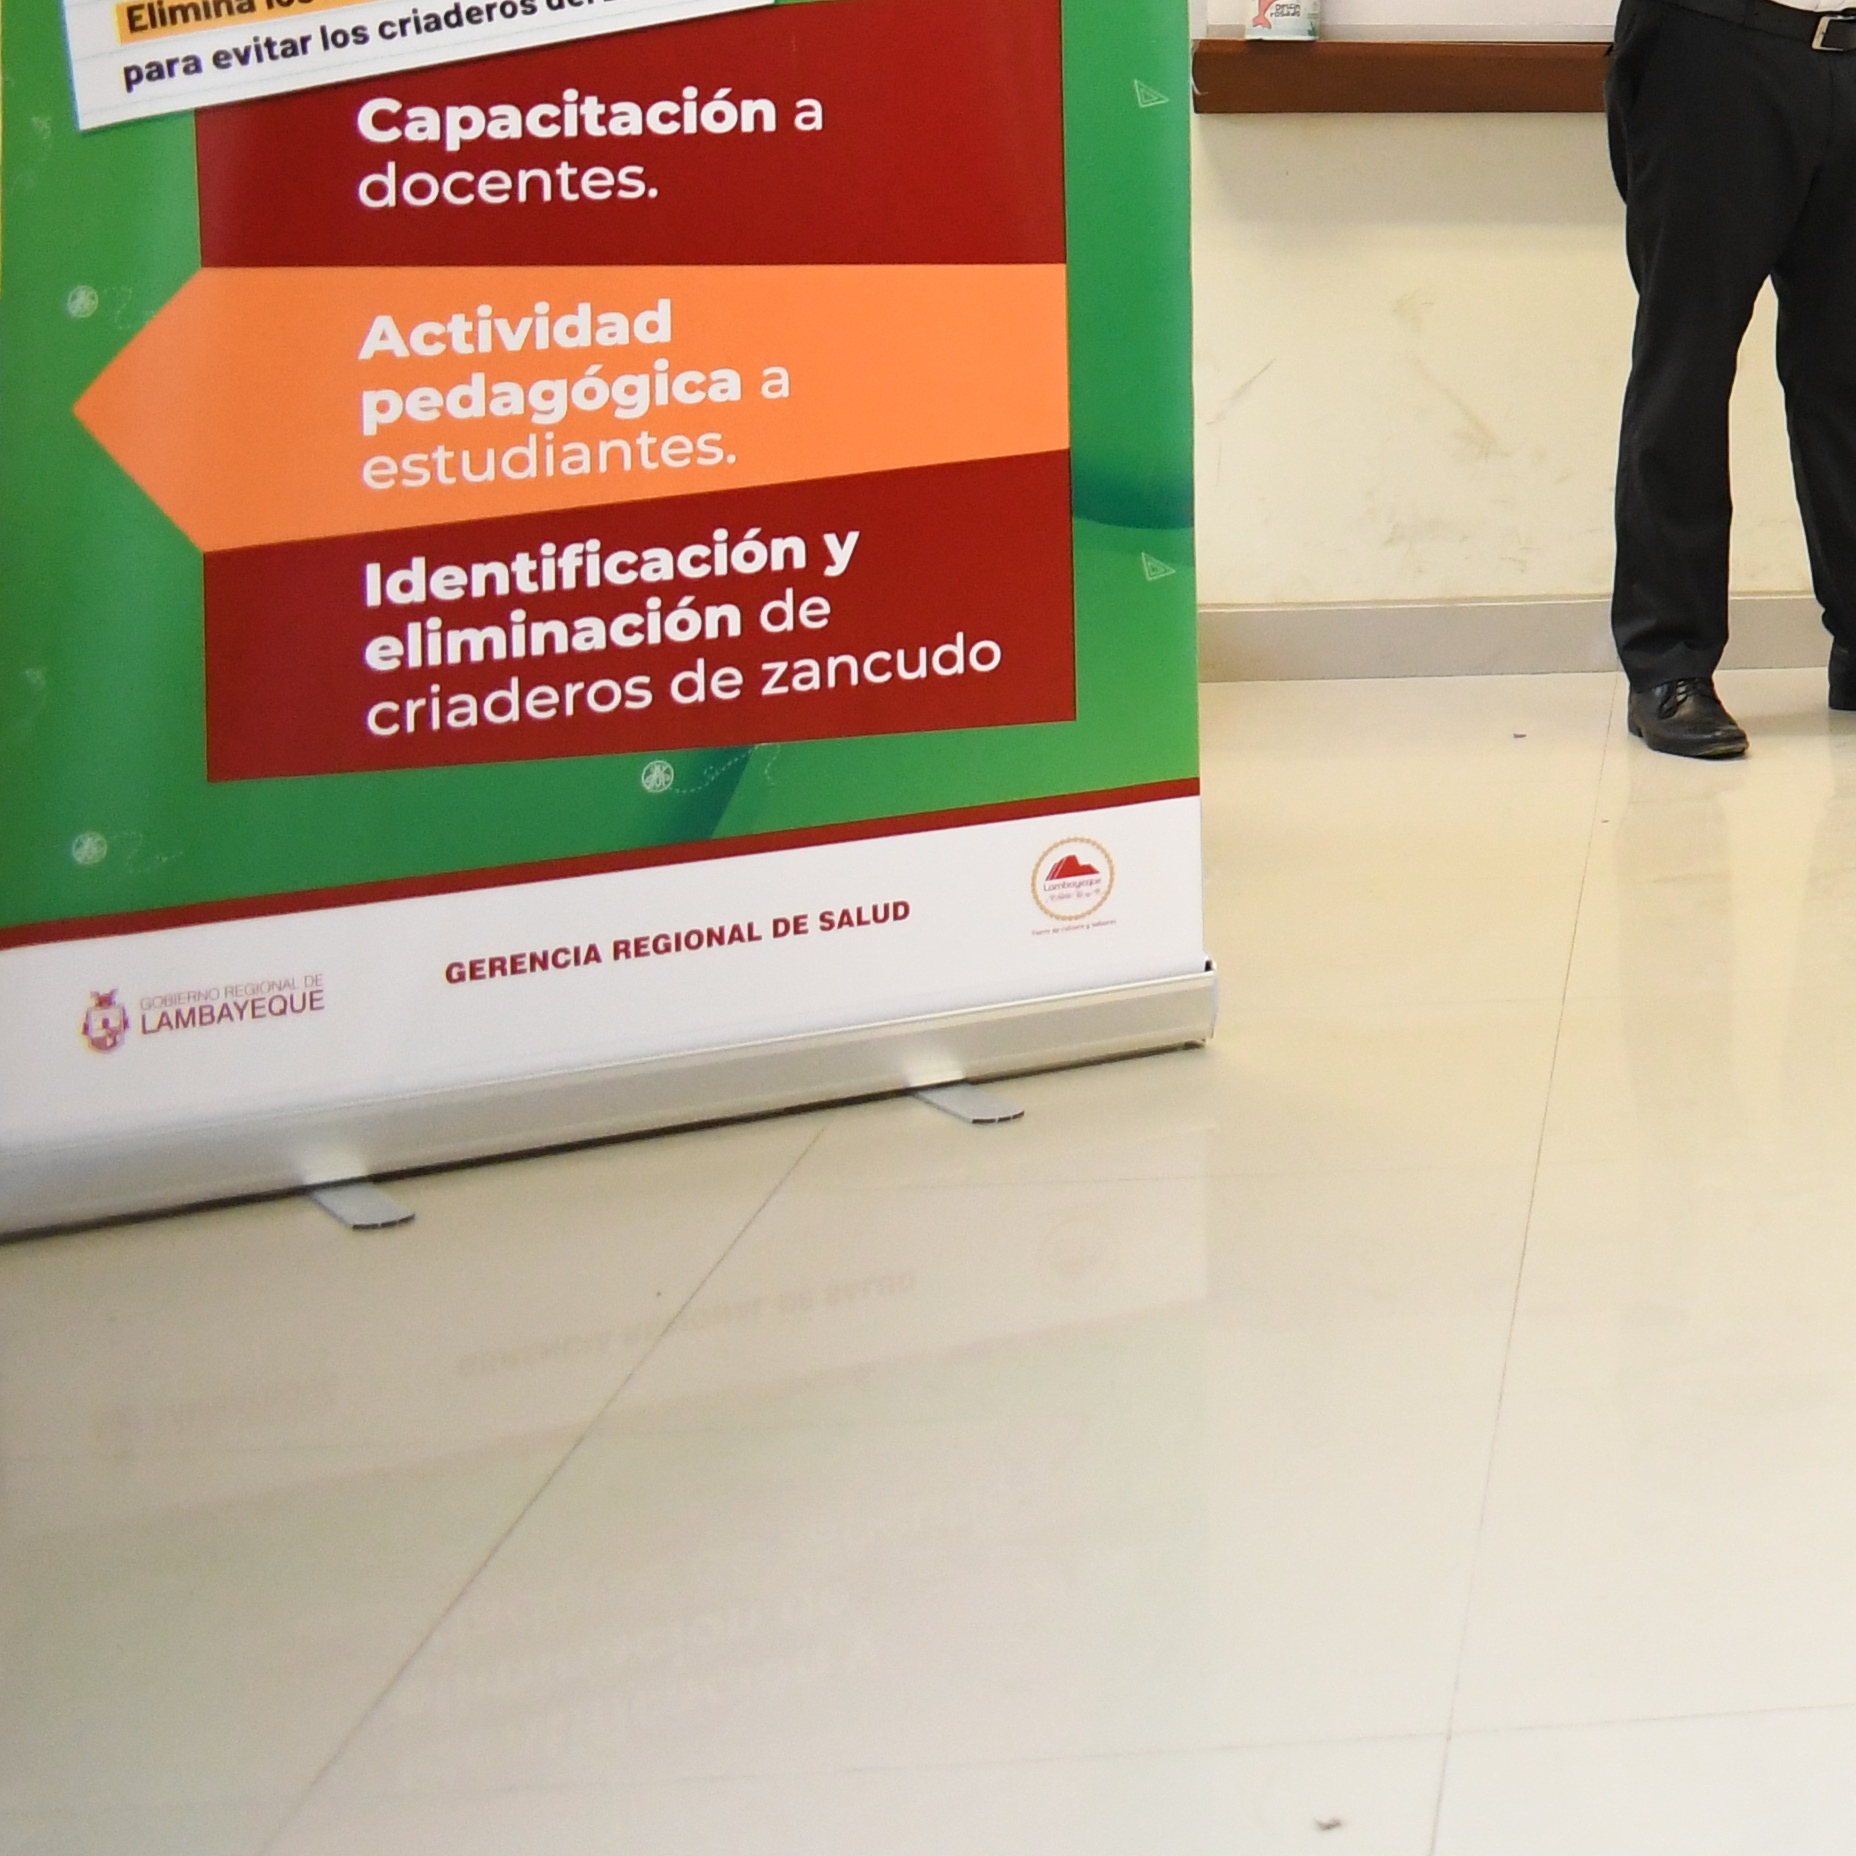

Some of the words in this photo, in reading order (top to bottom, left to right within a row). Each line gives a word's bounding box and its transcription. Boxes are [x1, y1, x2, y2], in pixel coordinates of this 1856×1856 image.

[123, 49, 203, 93] para
[211, 29, 312, 72] evitar
[320, 19, 370, 52] los
[356, 85, 777, 152] Capacitación
[793, 97, 824, 132] a
[357, 160, 660, 209] docentes.
[357, 297, 672, 360] Actividad
[360, 358, 743, 435] pedagógica
[760, 364, 790, 399] a
[361, 429, 738, 490] estudiantes.
[364, 526, 807, 608] Identificación
[822, 530, 860, 577] y
[363, 594, 742, 672] eliminación
[758, 587, 832, 633] de
[366, 672, 654, 737] criaderos
[670, 657, 743, 705] de
[760, 631, 1002, 697] zancudo
[445, 942, 602, 985] GERENCIA
[612, 919, 762, 962] REGIONAL
[772, 913, 809, 940] DE
[819, 899, 911, 933] SALUD
[139, 987, 220, 1011] GOBIERNO
[224, 978, 297, 1000] REGIONAL
[304, 973, 324, 988] DE
[141, 989, 325, 1035] LAMBAYEQUE
